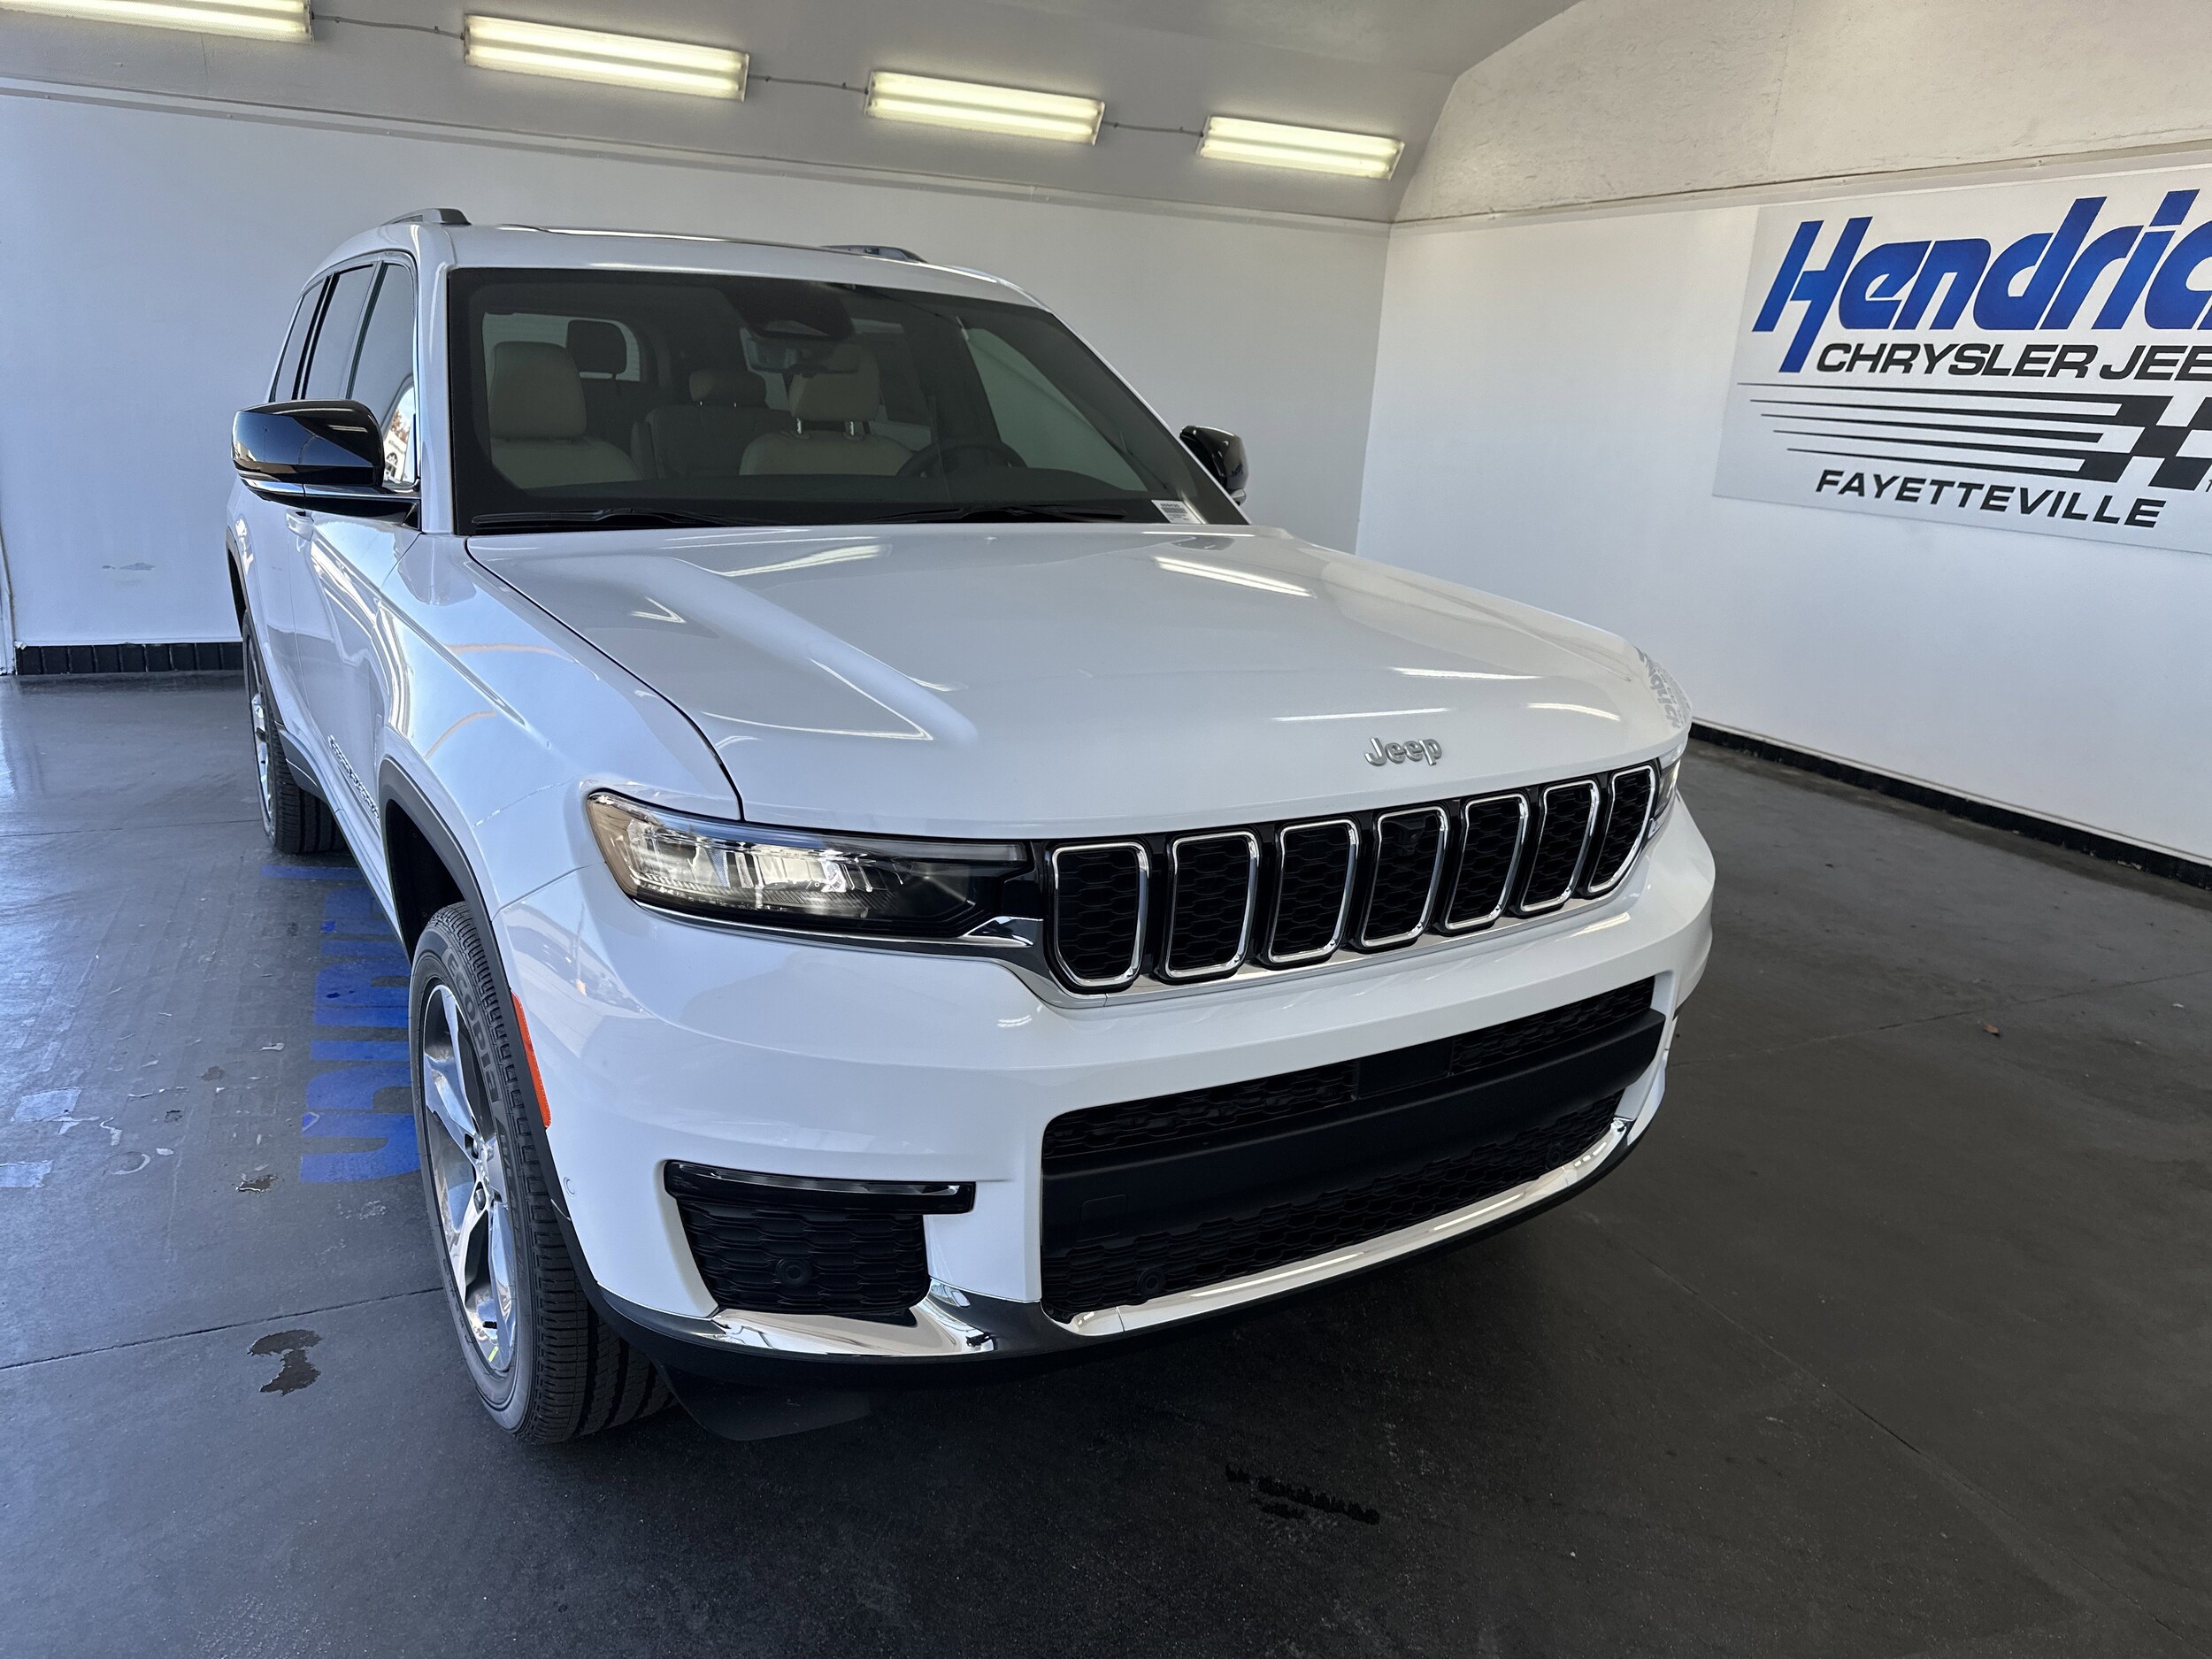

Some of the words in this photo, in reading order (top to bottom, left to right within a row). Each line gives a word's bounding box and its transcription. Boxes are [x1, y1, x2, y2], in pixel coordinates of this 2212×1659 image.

[1752, 188, 2212, 373] Hendric
[1816, 343, 2099, 379] CHRYSLER
[1816, 470, 2167, 528] FAYETTEVILLE
[1364, 738, 1442, 766] Jeep
[447, 952, 499, 1102] ECOPIA
